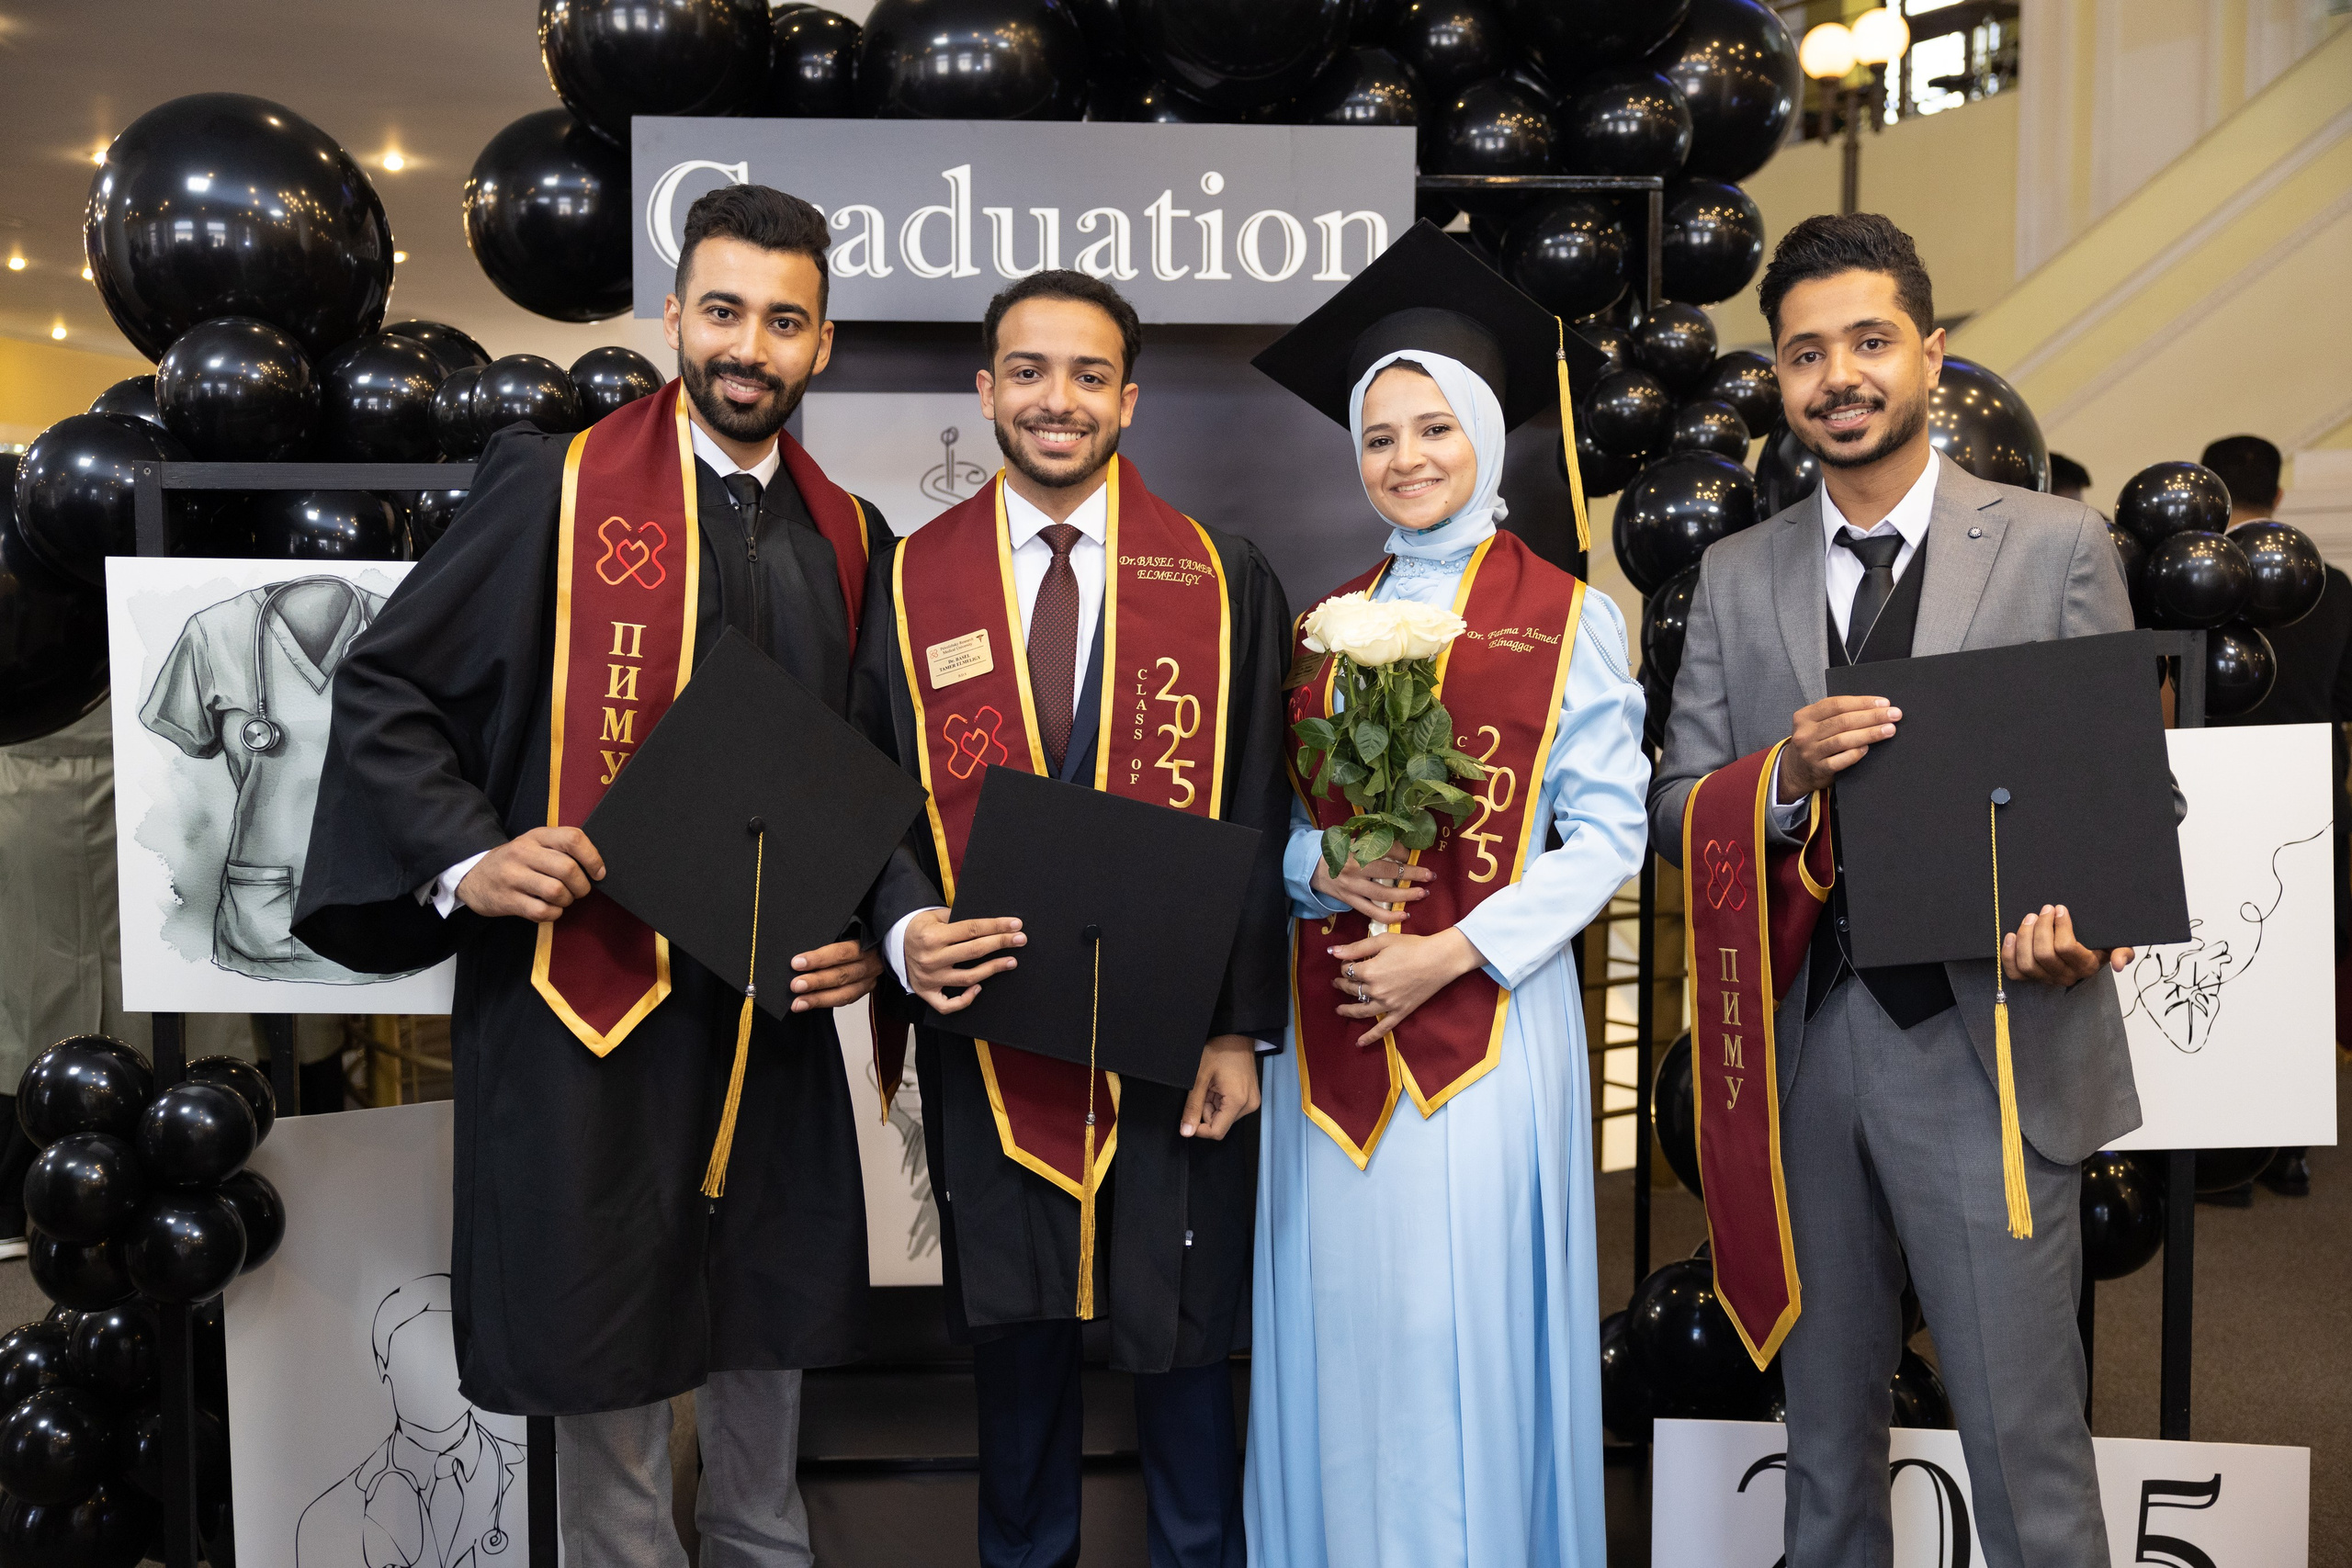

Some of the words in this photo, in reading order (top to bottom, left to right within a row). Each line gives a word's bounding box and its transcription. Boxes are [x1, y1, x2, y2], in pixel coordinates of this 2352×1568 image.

[646, 160, 1388, 282] Gaduation
[1136, 570, 1202, 586] ELMELIGY
[1178, 558, 1216, 578] TAMER
[1467, 631, 1484, 639] Dr.
[1487, 627, 1519, 639] Fatma
[1522, 626, 1561, 644] Ahmed
[1487, 637, 1535, 652] Elnaggar
[600, 621, 647, 785] ПИМУ
[1134, 669, 1148, 740] CLASS
[1154, 657, 1201, 808] 2025
[1130, 759, 1142, 784] OF
[1459, 725, 1516, 883] 2025
[1438, 826, 1451, 852] OF
[1718, 947, 1745, 1110] ПИМУ
